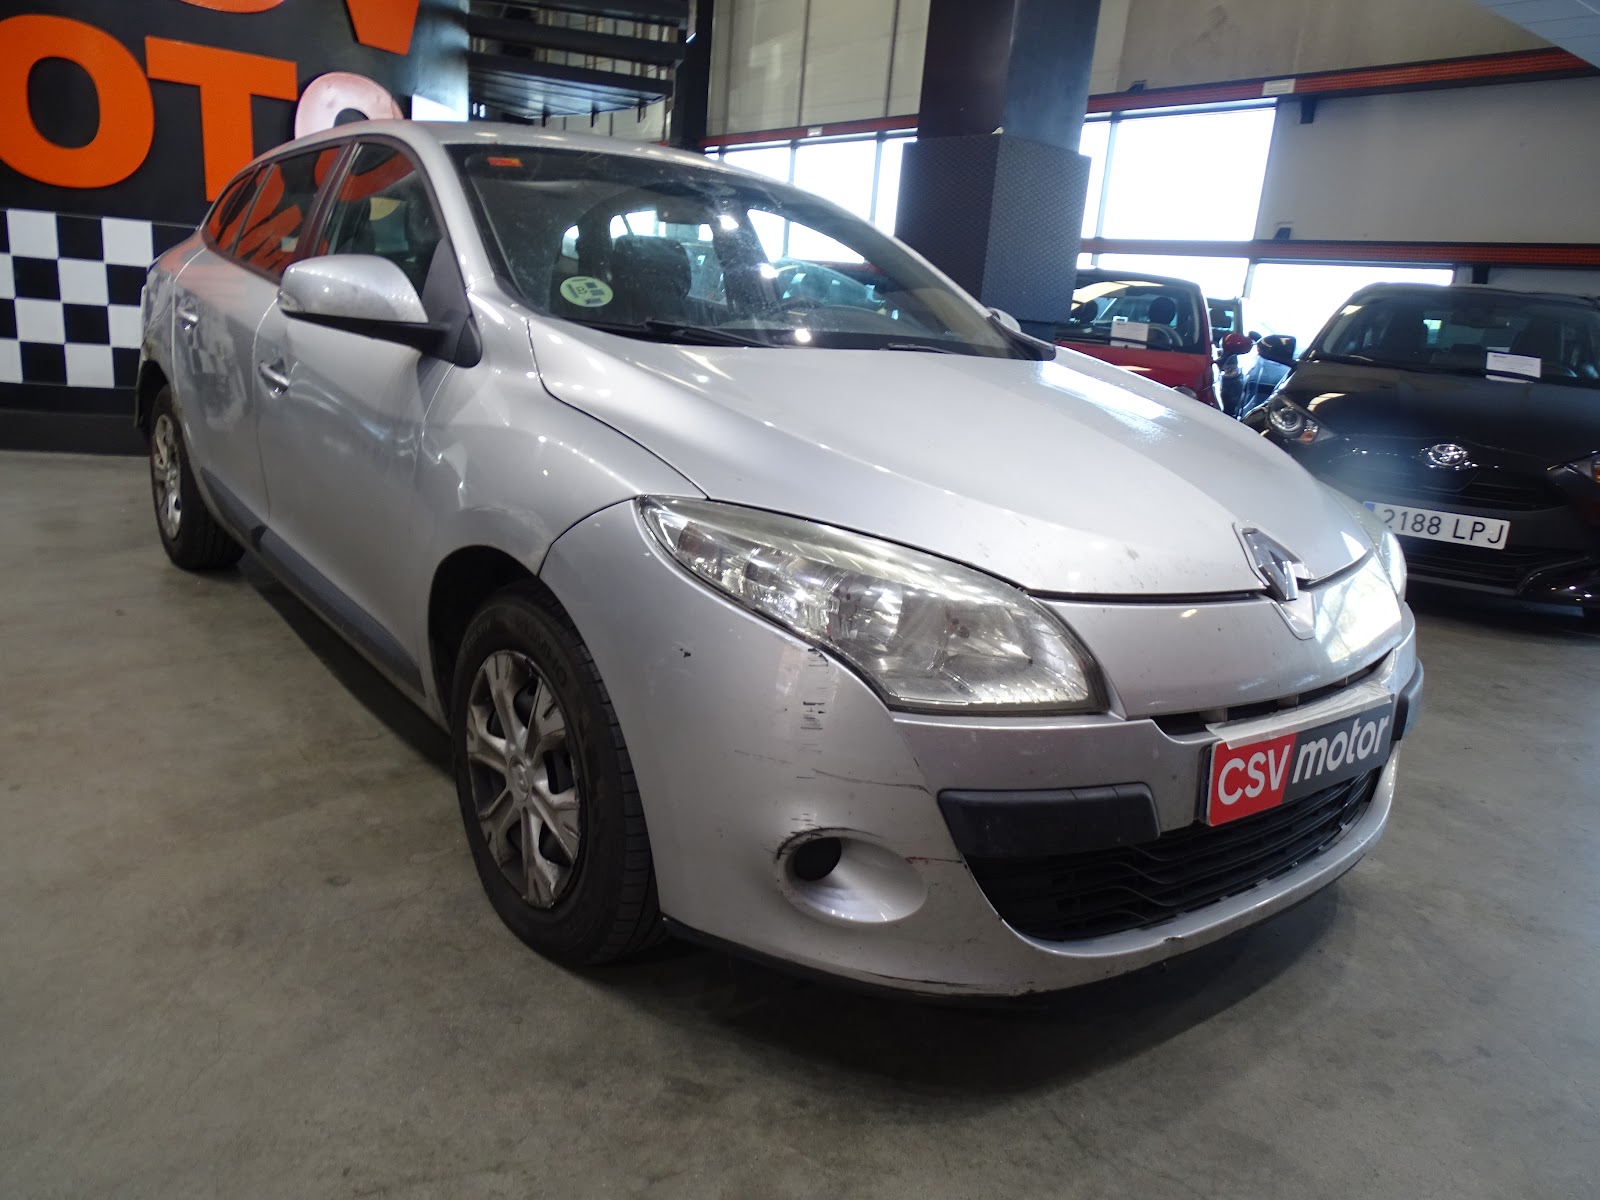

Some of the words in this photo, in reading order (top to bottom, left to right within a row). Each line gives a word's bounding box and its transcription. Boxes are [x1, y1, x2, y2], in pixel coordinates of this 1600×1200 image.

[1383, 508, 1442, 535] 2188
[1452, 518, 1504, 544] LPJ
[1217, 744, 1290, 806] CSV
[1292, 714, 1390, 785] motor
